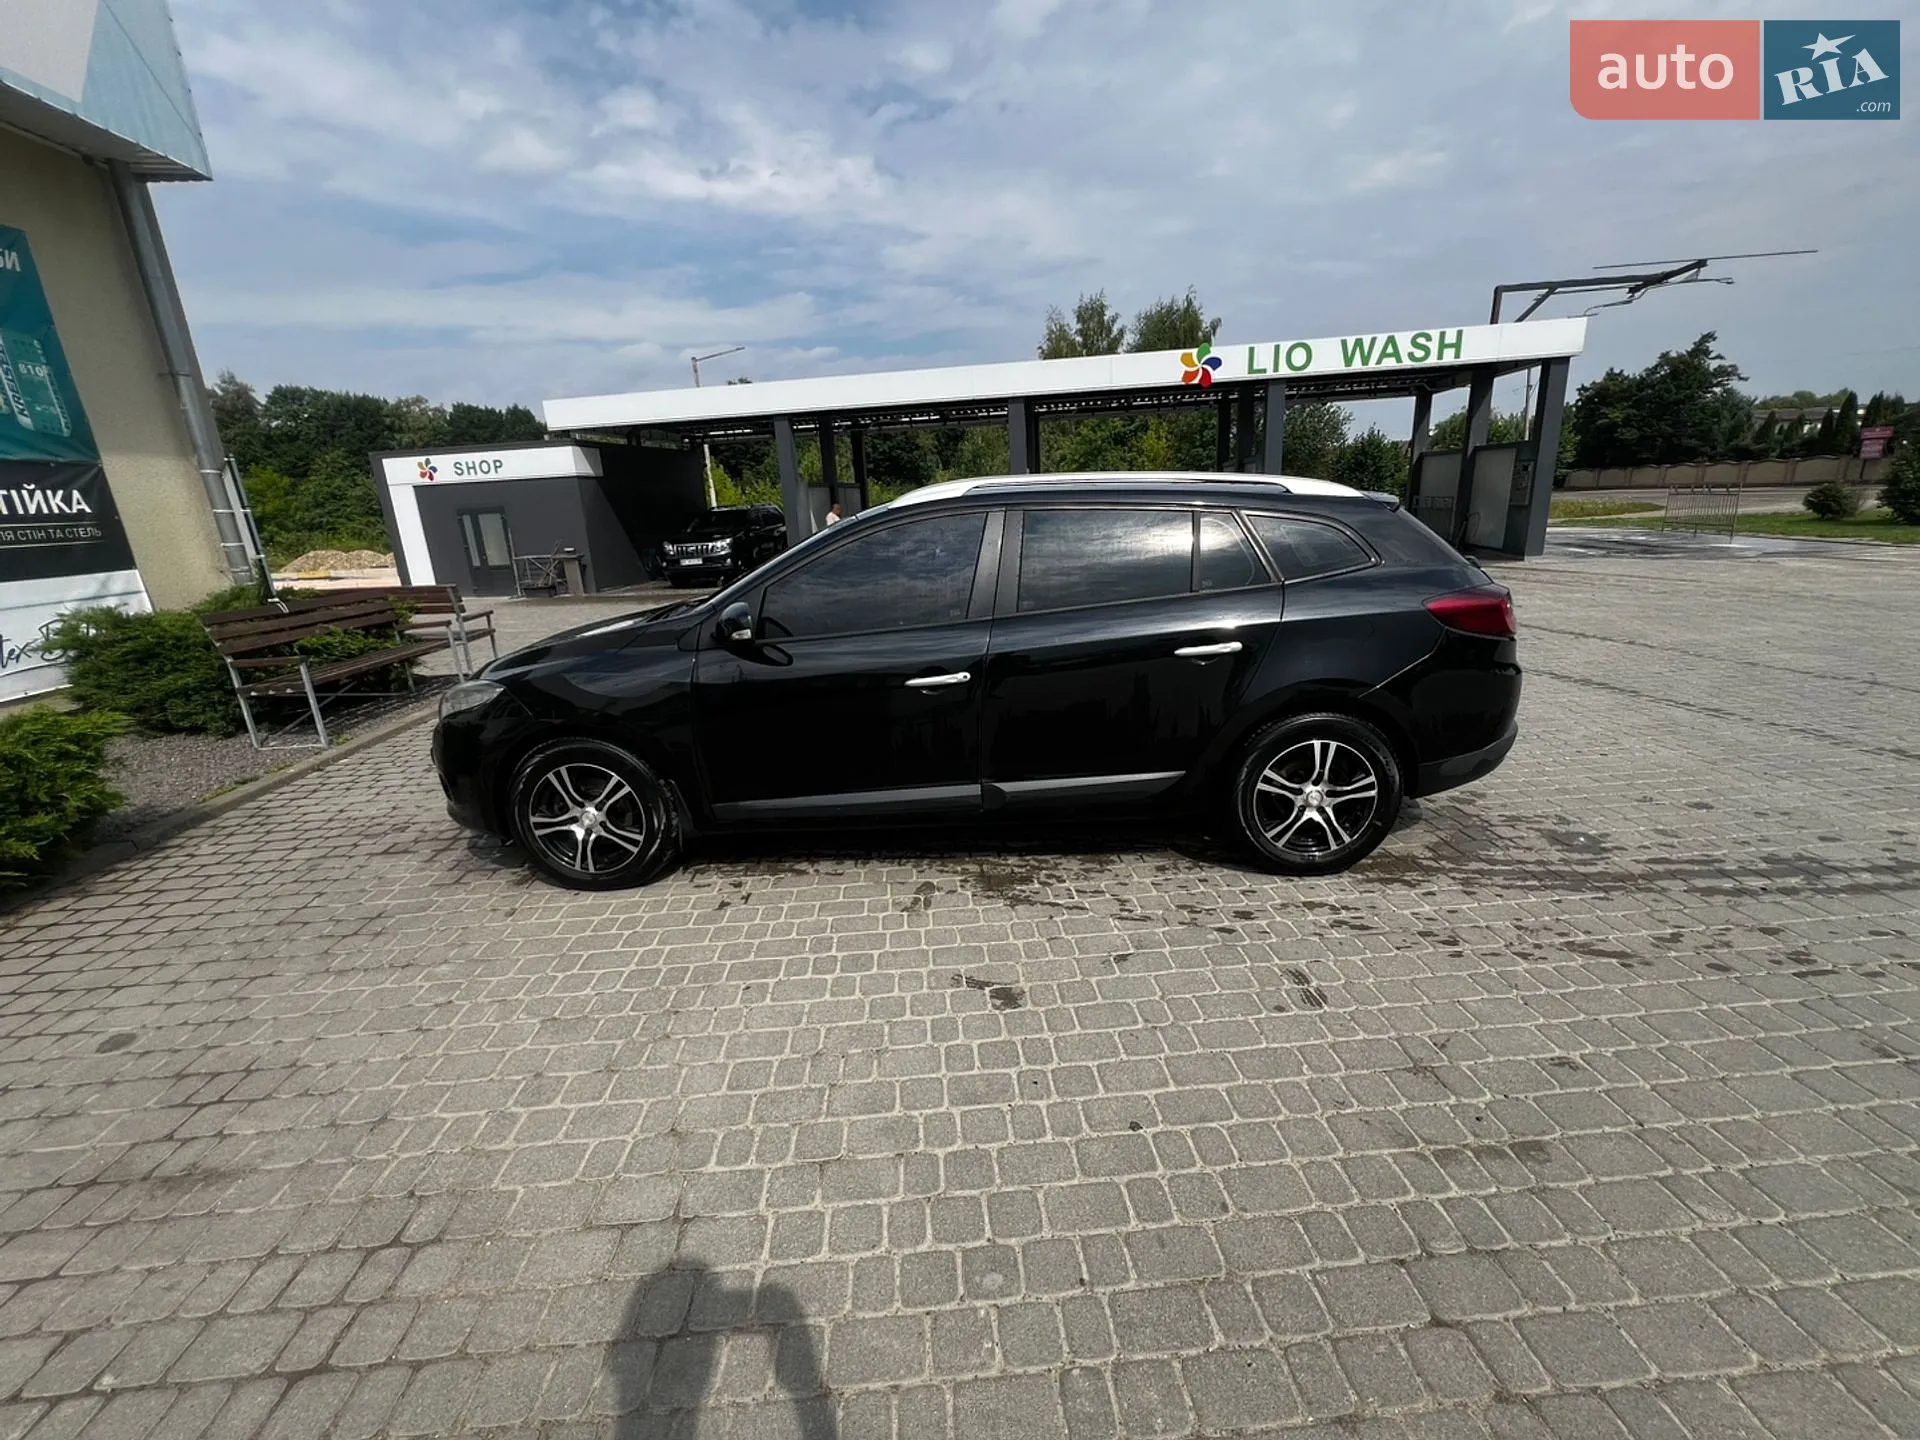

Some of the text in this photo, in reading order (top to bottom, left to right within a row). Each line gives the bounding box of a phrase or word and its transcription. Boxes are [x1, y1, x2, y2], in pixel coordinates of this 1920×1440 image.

[1247, 329, 1464, 375] LIO WASH
[453, 459, 504, 477] SHOP
[17, 529, 46, 541] СТІН
[47, 528, 65, 539] ТА
